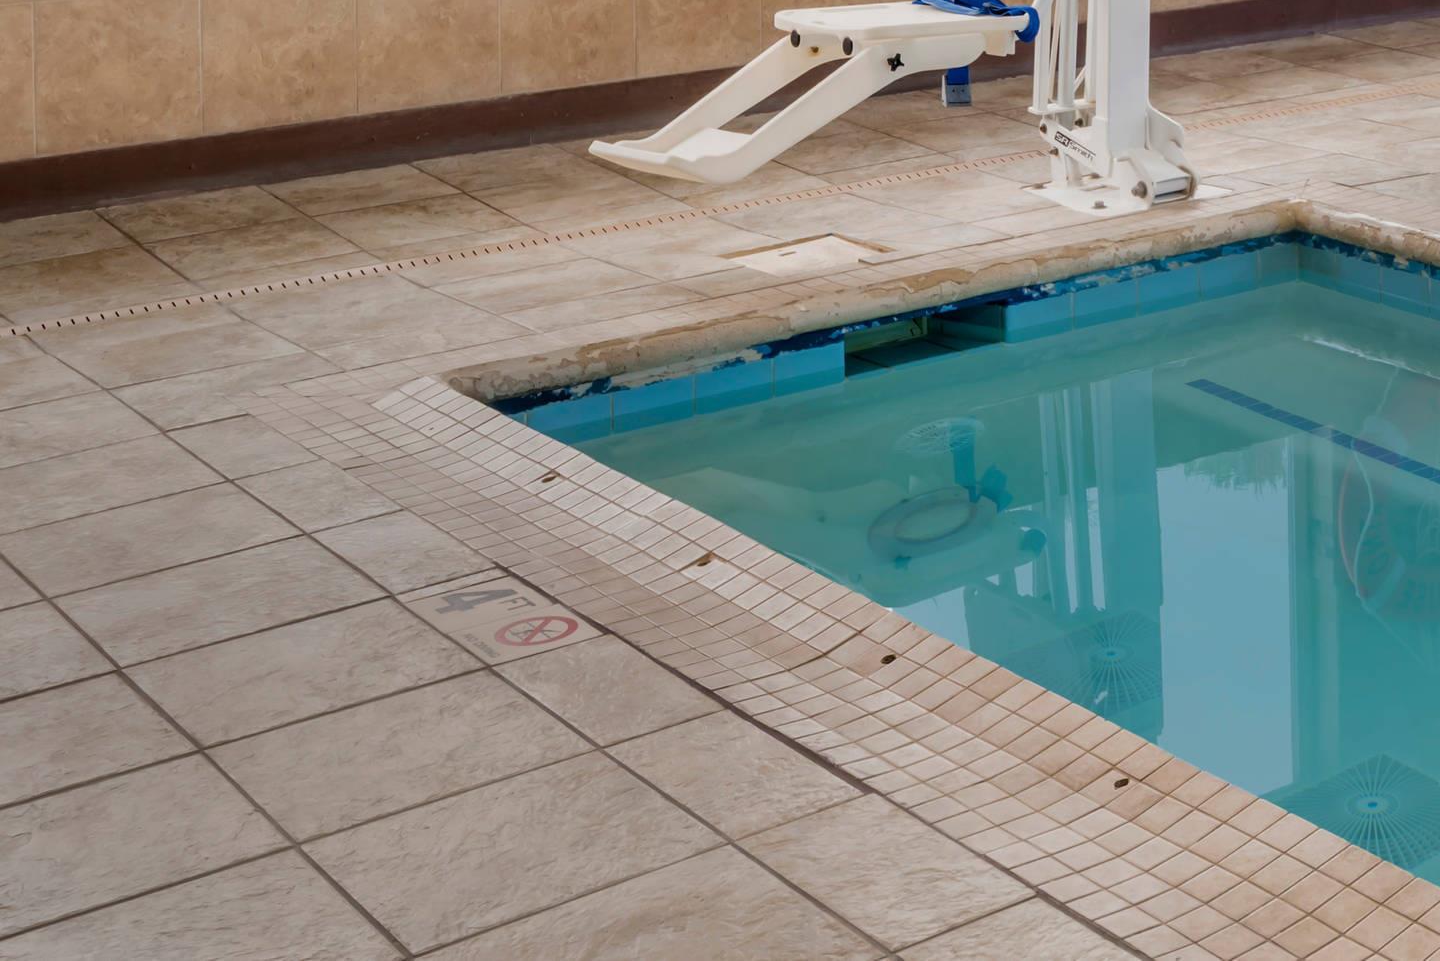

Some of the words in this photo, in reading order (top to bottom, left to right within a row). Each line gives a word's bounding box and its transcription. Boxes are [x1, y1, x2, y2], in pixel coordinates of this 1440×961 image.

[1054, 131, 1070, 147] SR
[435, 588, 518, 615] 4
[500, 596, 536, 611] FT
